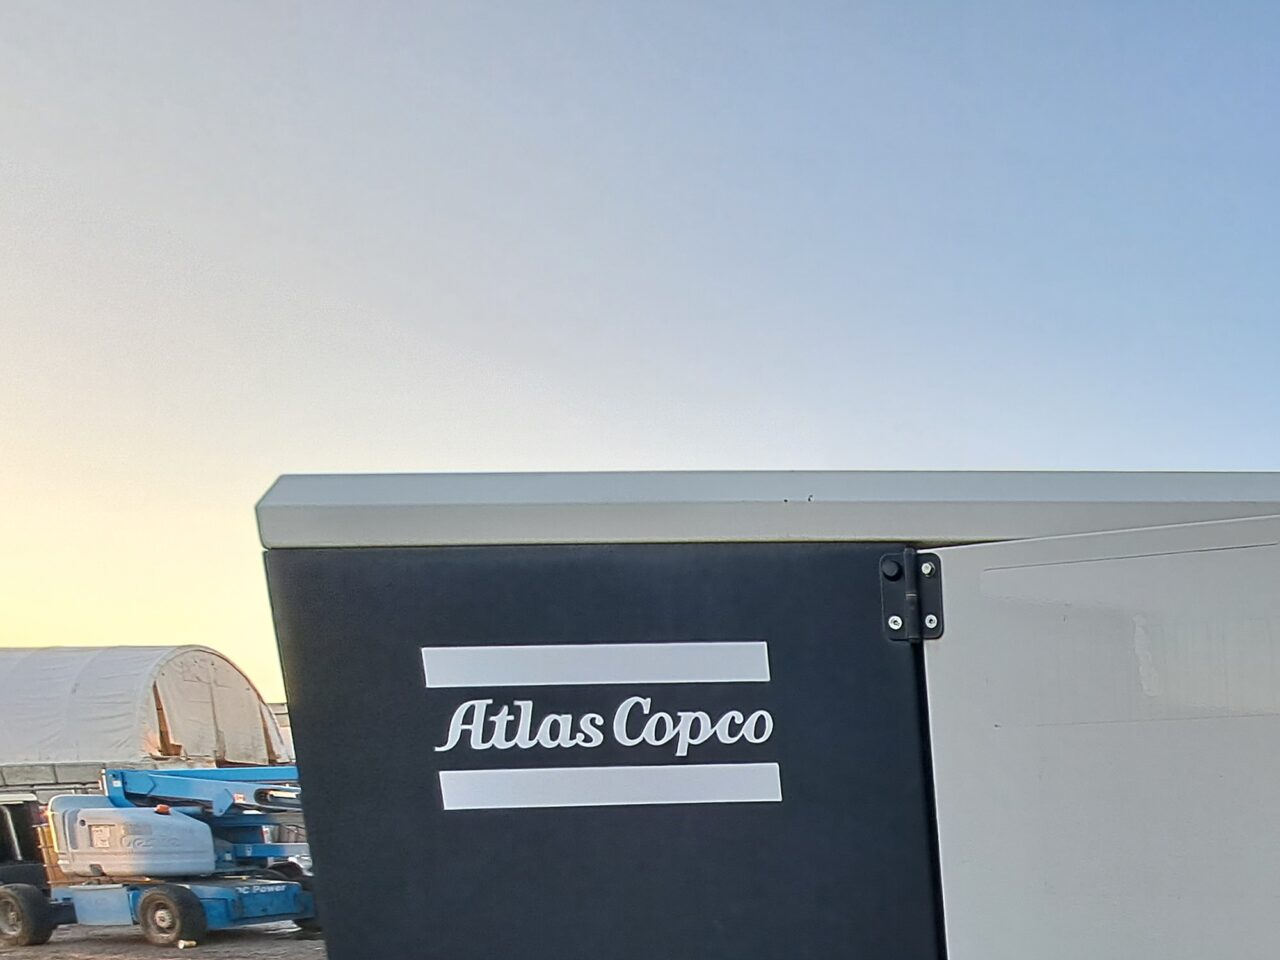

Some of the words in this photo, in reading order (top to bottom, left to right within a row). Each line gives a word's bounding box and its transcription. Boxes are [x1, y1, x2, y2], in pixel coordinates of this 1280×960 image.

[434, 698, 604, 752] Atlas
[614, 696, 774, 756] Copco
[252, 885, 287, 893] Power
